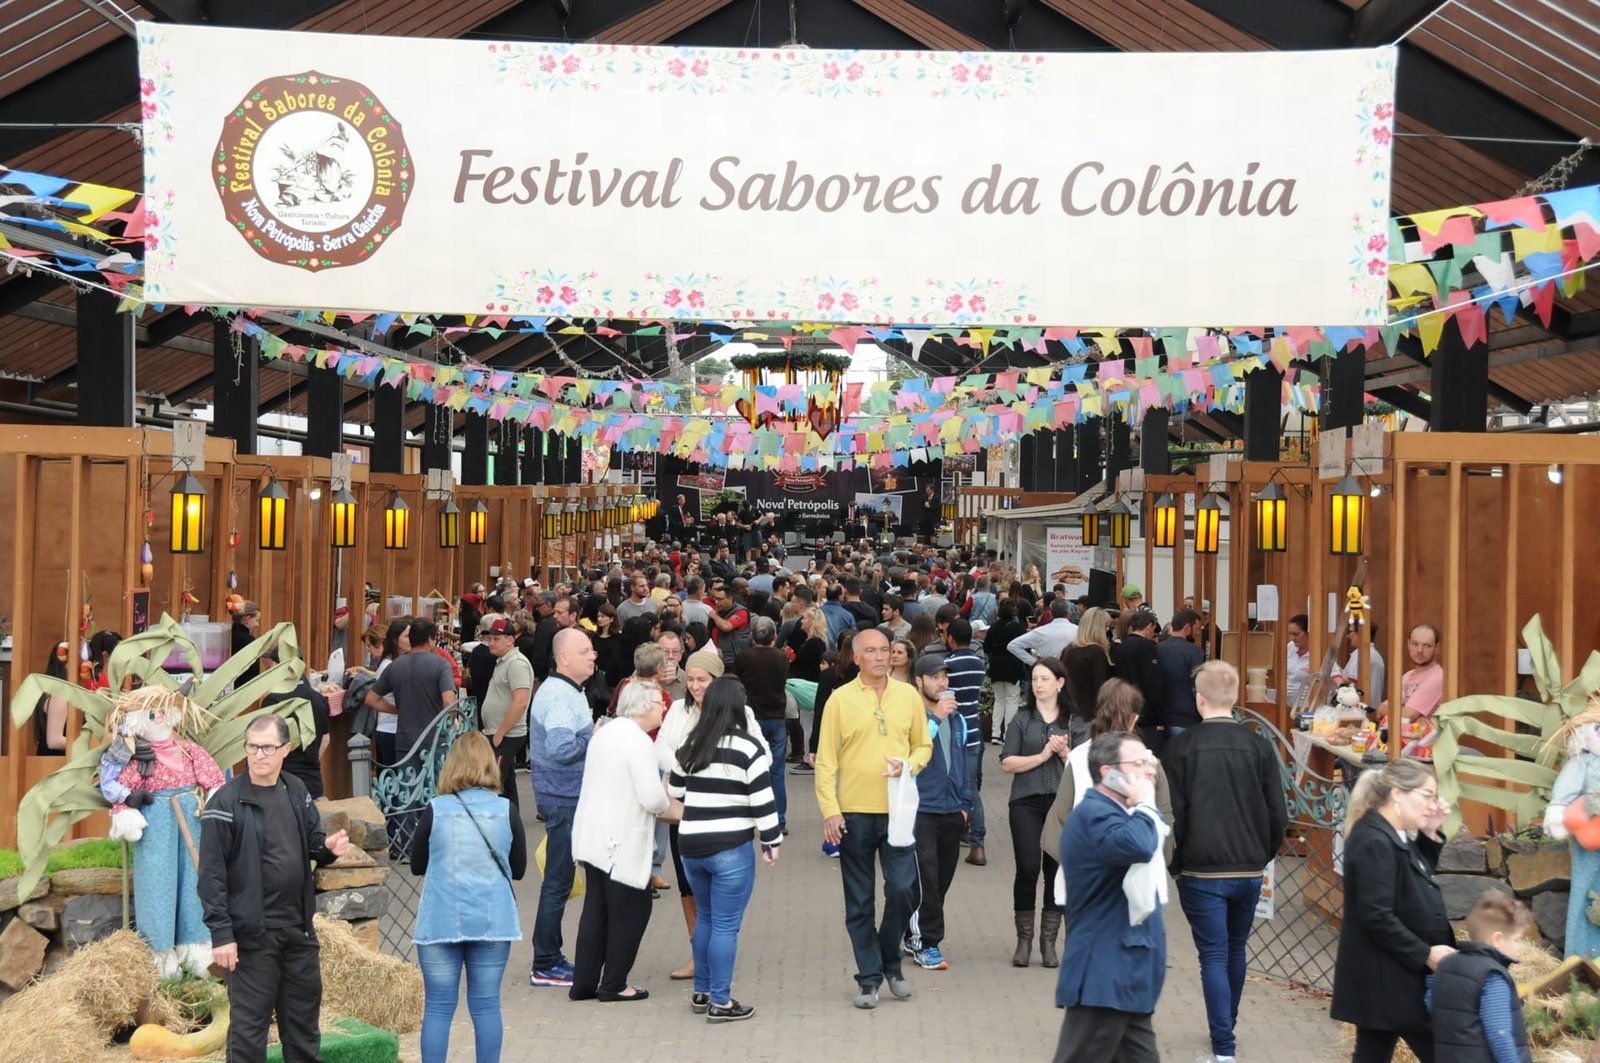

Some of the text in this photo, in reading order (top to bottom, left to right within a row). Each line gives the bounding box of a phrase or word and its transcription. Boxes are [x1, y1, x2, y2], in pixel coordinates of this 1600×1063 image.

[229, 90, 396, 196] Festival Sabores da Colônia
[452, 149, 1299, 217] Festival Sabores da Colônia
[241, 197, 263, 227] Nova
[261, 220, 315, 252] Petrópolis
[322, 233, 355, 251] Serra
[351, 203, 387, 235] Gaúcha
[756, 498, 840, 513] Nova Petrópolis
